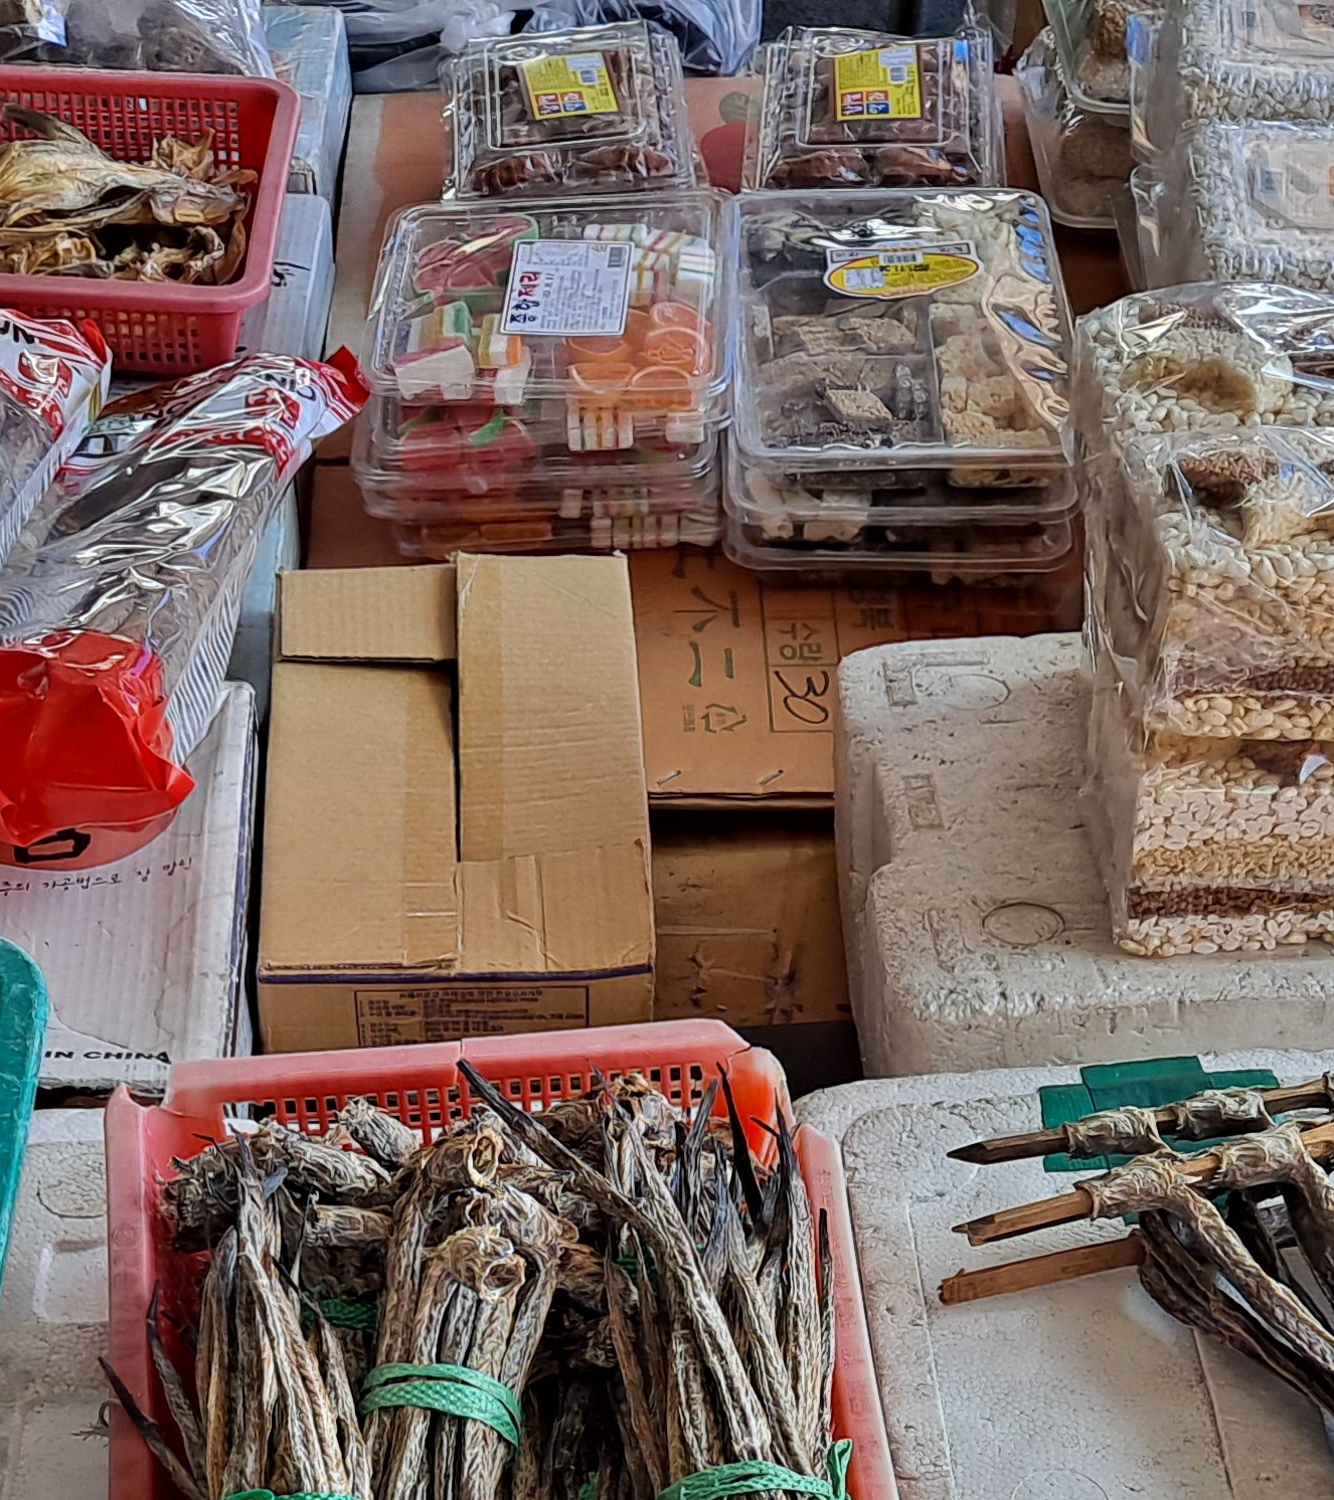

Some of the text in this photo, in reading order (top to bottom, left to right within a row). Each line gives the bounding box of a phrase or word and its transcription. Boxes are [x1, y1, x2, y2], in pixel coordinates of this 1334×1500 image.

[778, 622, 823, 661] 수량
[773, 670, 830, 725] 30
[43, 873, 123, 891] 가공법으로
[45, 1051, 171, 1064] IN CHINA
